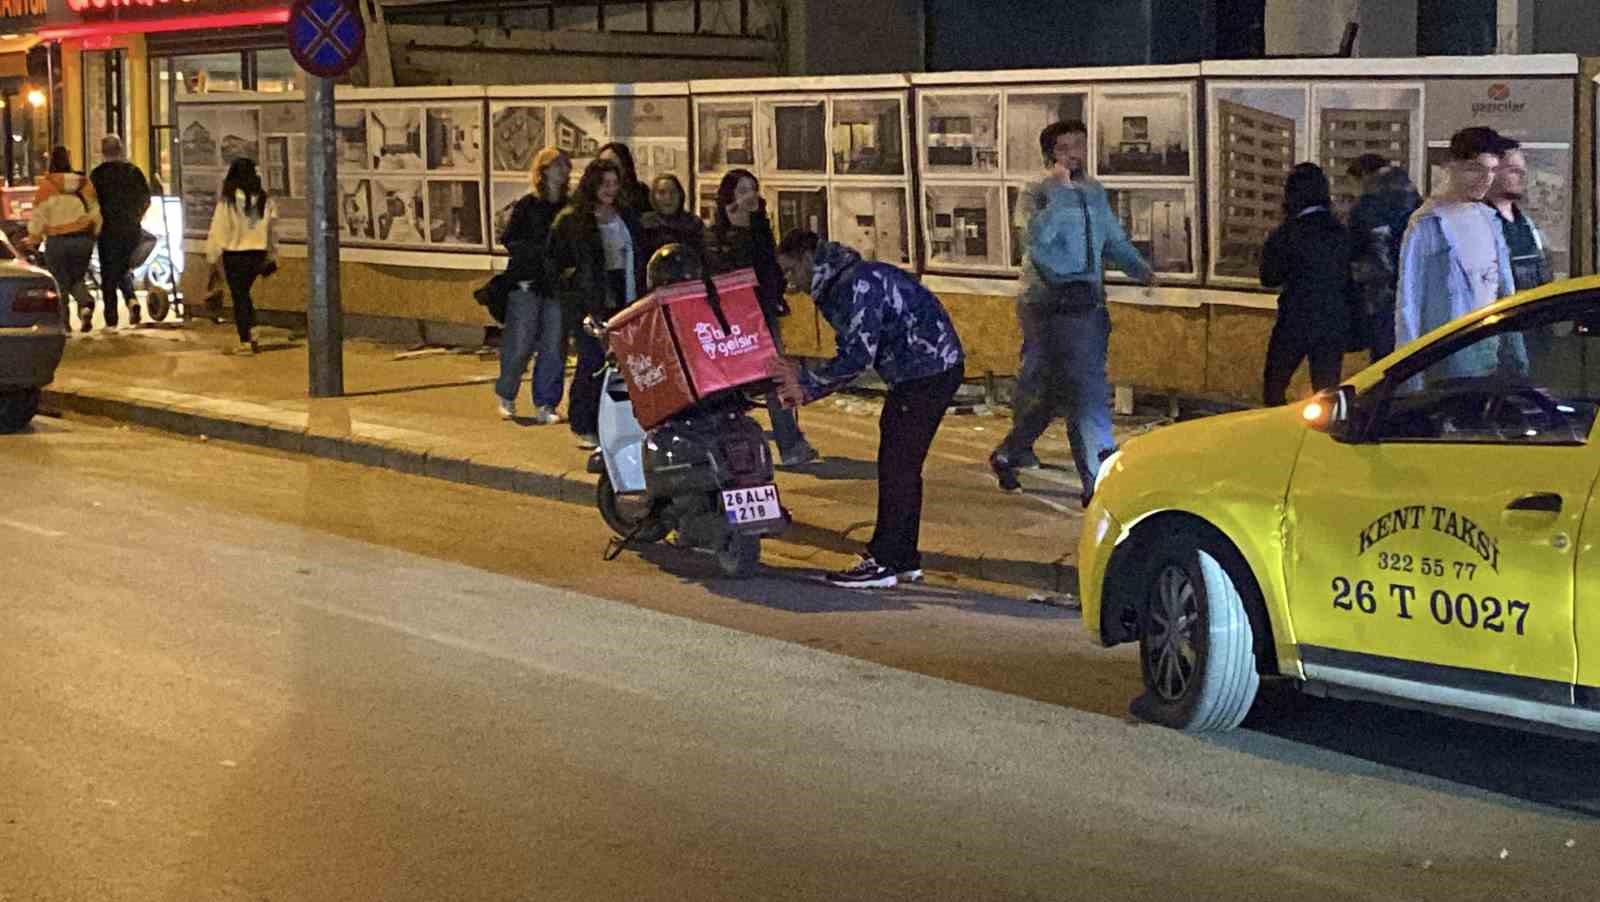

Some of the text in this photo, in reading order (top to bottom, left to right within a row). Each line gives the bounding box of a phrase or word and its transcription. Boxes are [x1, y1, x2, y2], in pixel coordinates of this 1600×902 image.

[1358, 506, 1424, 556] KENT
[1378, 552, 1477, 580] 322 55 77
[1331, 576, 1530, 636] 26 T 0027
